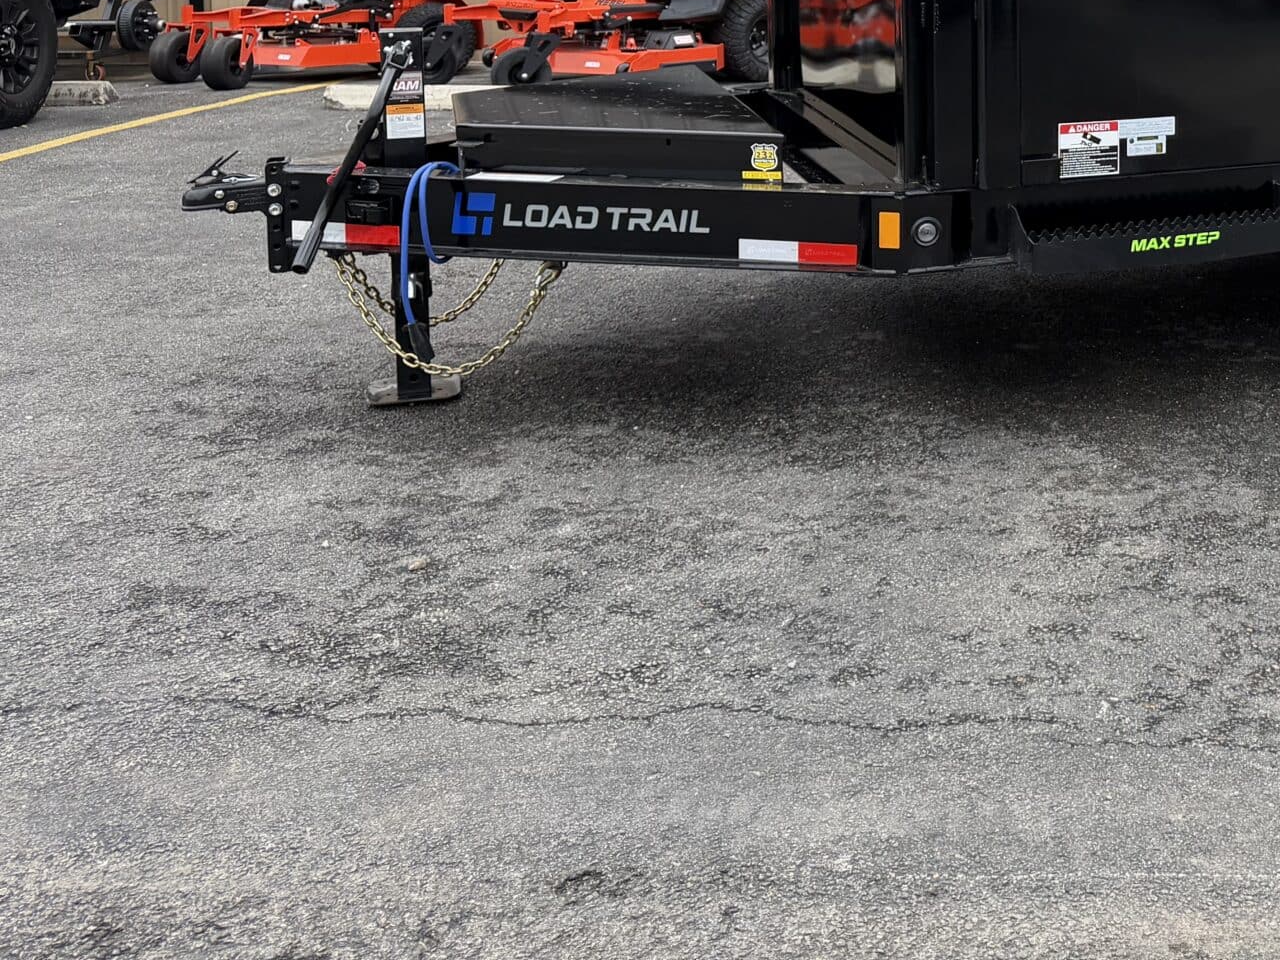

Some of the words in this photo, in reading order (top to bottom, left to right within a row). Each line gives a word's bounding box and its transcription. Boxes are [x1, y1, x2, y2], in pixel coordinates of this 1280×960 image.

[1076, 123, 1111, 132] DANGER
[503, 203, 599, 230] LOAD
[606, 207, 711, 234] TRAIL
[1130, 236, 1171, 253] MAX
[1174, 231, 1221, 248] STEP
